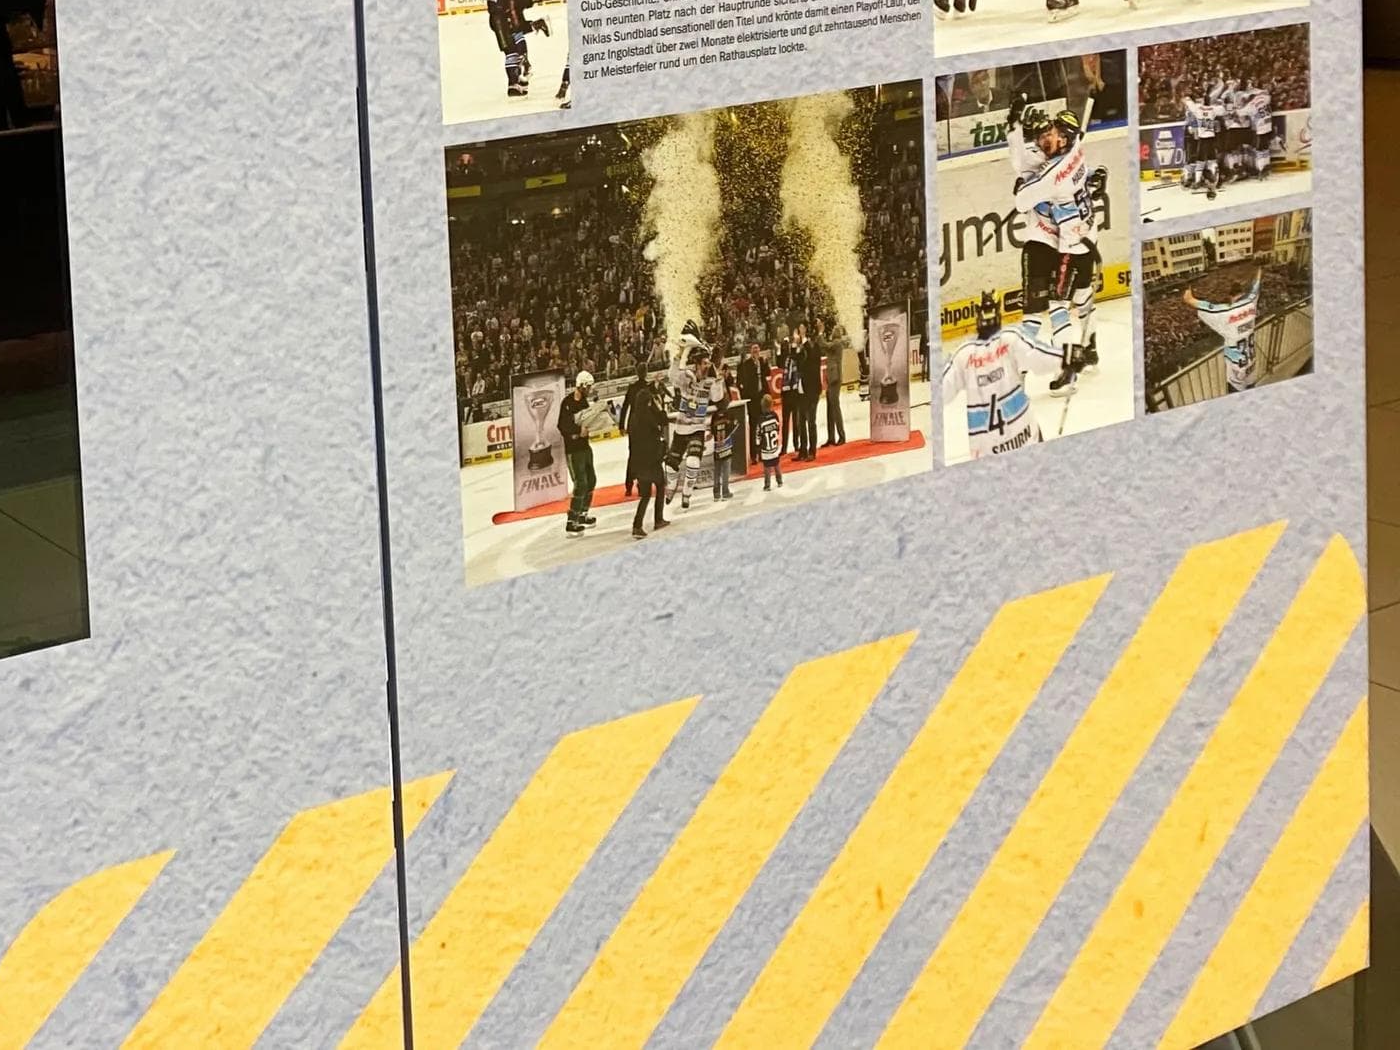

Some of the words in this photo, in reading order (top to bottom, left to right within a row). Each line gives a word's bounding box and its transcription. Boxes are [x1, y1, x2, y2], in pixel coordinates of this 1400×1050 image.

[580, 17, 603, 29] Vom
[605, 13, 645, 27] neunten
[648, 9, 672, 21] Platz
[674, 5, 697, 18] nach
[699, 3, 716, 15] der
[581, 33, 613, 46] Niklas
[613, 26, 659, 43] Sundblad
[659, 19, 716, 37] sensationell
[716, 18, 735, 30] den
[735, 14, 755, 27] Titel
[756, 12, 774, 25] und
[775, 10, 804, 22] krönte
[804, 5, 830, 19] damit
[830, 4, 855, 16] einen
[582, 51, 606, 66] ganz
[607, 44, 655, 61] Ingolstadt
[655, 42, 678, 54] über
[678, 37, 700, 51] zwei
[700, 35, 736, 48] Monate
[736, 28, 789, 44] elektrisierte
[790, 24, 808, 37] und
[808, 23, 824, 37] gut
[823, 15, 879, 33] zehntausend
[879, 11, 922, 25] Menschen
[583, 69, 600, 80] zur
[600, 61, 658, 78] Meisterfeier
[659, 56, 681, 70] rund
[682, 56, 698, 67] um
[699, 53, 718, 65] den
[719, 45, 777, 62] Rathausplatz
[872, 410, 906, 427] FINALE
[988, 393, 1005, 436] 4
[764, 430, 779, 451] 12
[517, 470, 566, 497] FINALE
